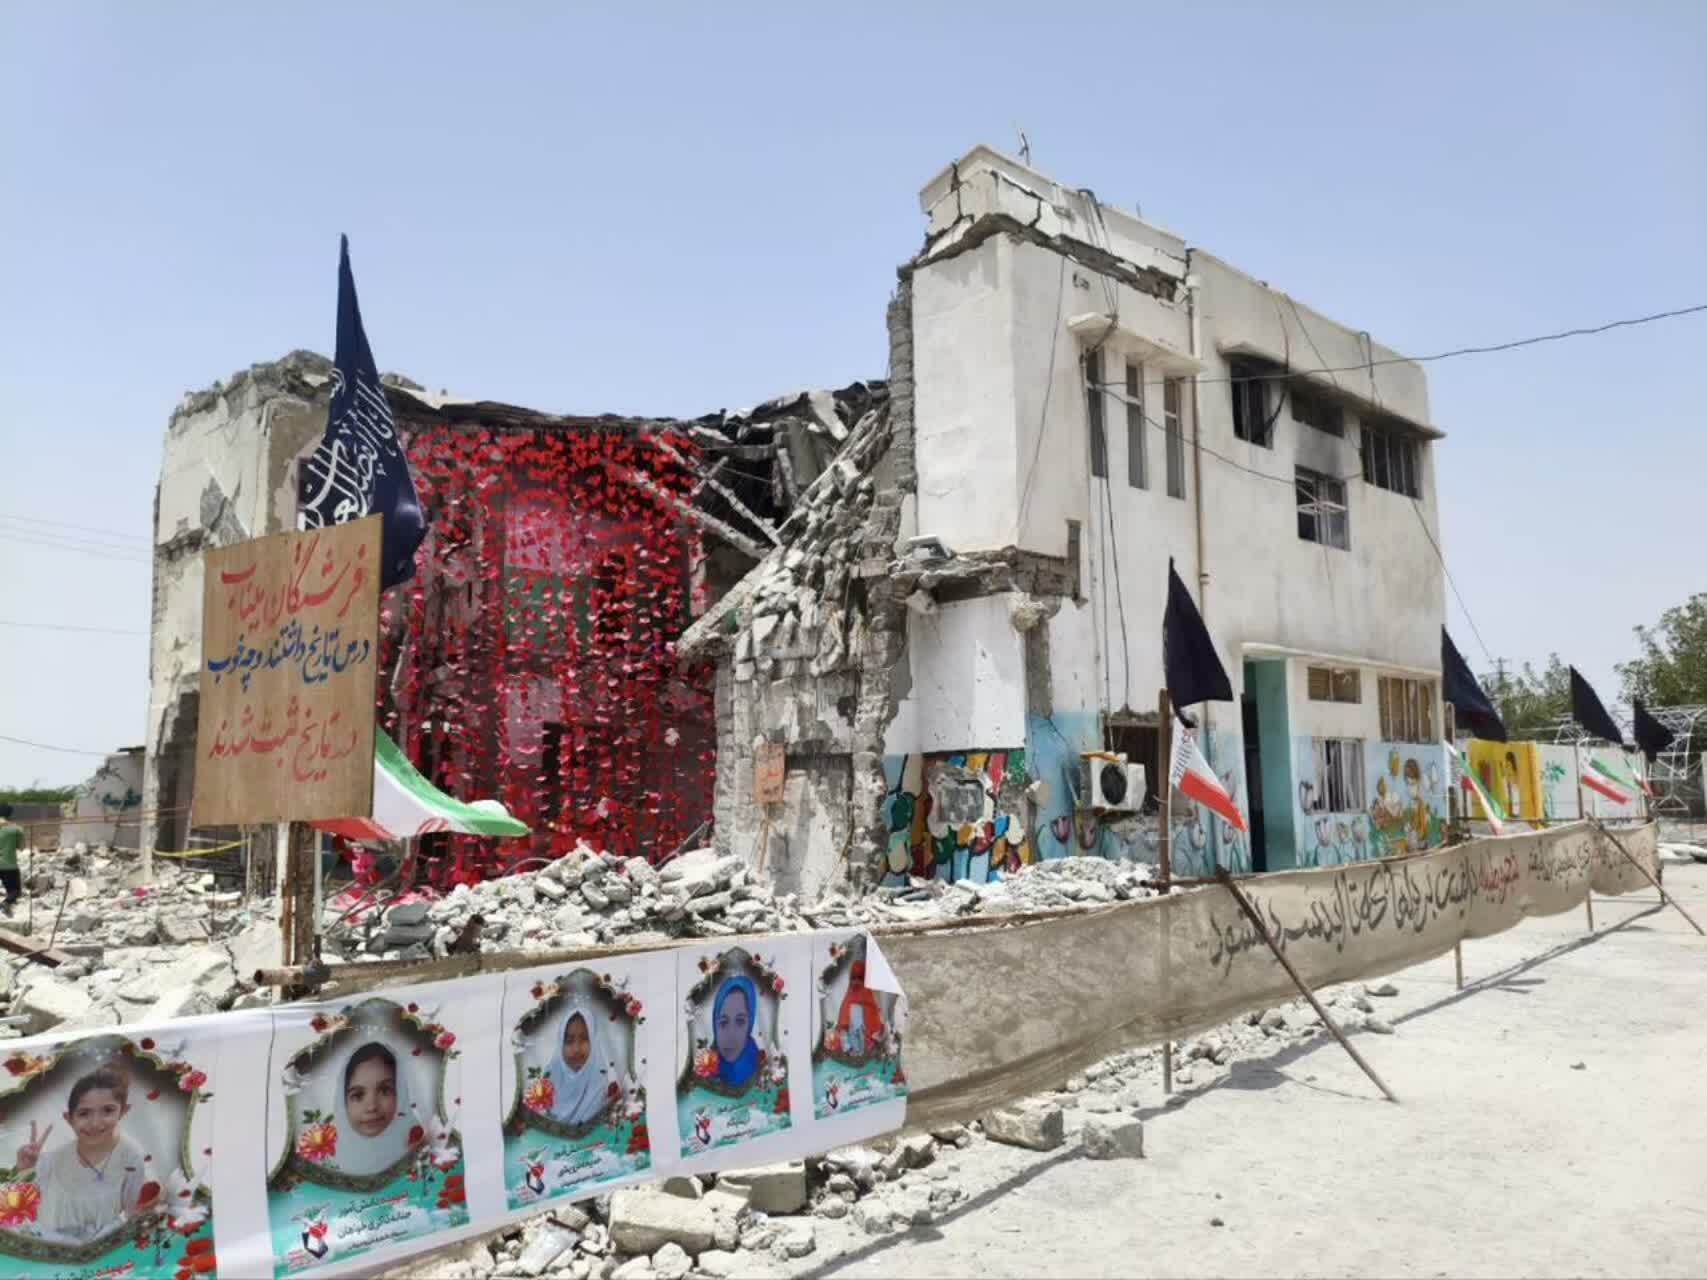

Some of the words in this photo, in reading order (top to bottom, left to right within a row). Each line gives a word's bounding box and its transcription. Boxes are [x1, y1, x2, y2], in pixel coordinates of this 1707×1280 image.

[221, 562, 264, 630] میناب
[264, 533, 367, 624] فرشتگان
[207, 634, 245, 685] خوب
[265, 619, 306, 670] داشتند
[302, 626, 340, 684] تاریخ
[333, 638, 370, 673] درس
[208, 704, 254, 760] شدند
[252, 695, 298, 768] ثبت
[292, 708, 341, 782] تاریخ
[332, 728, 358, 760] در
